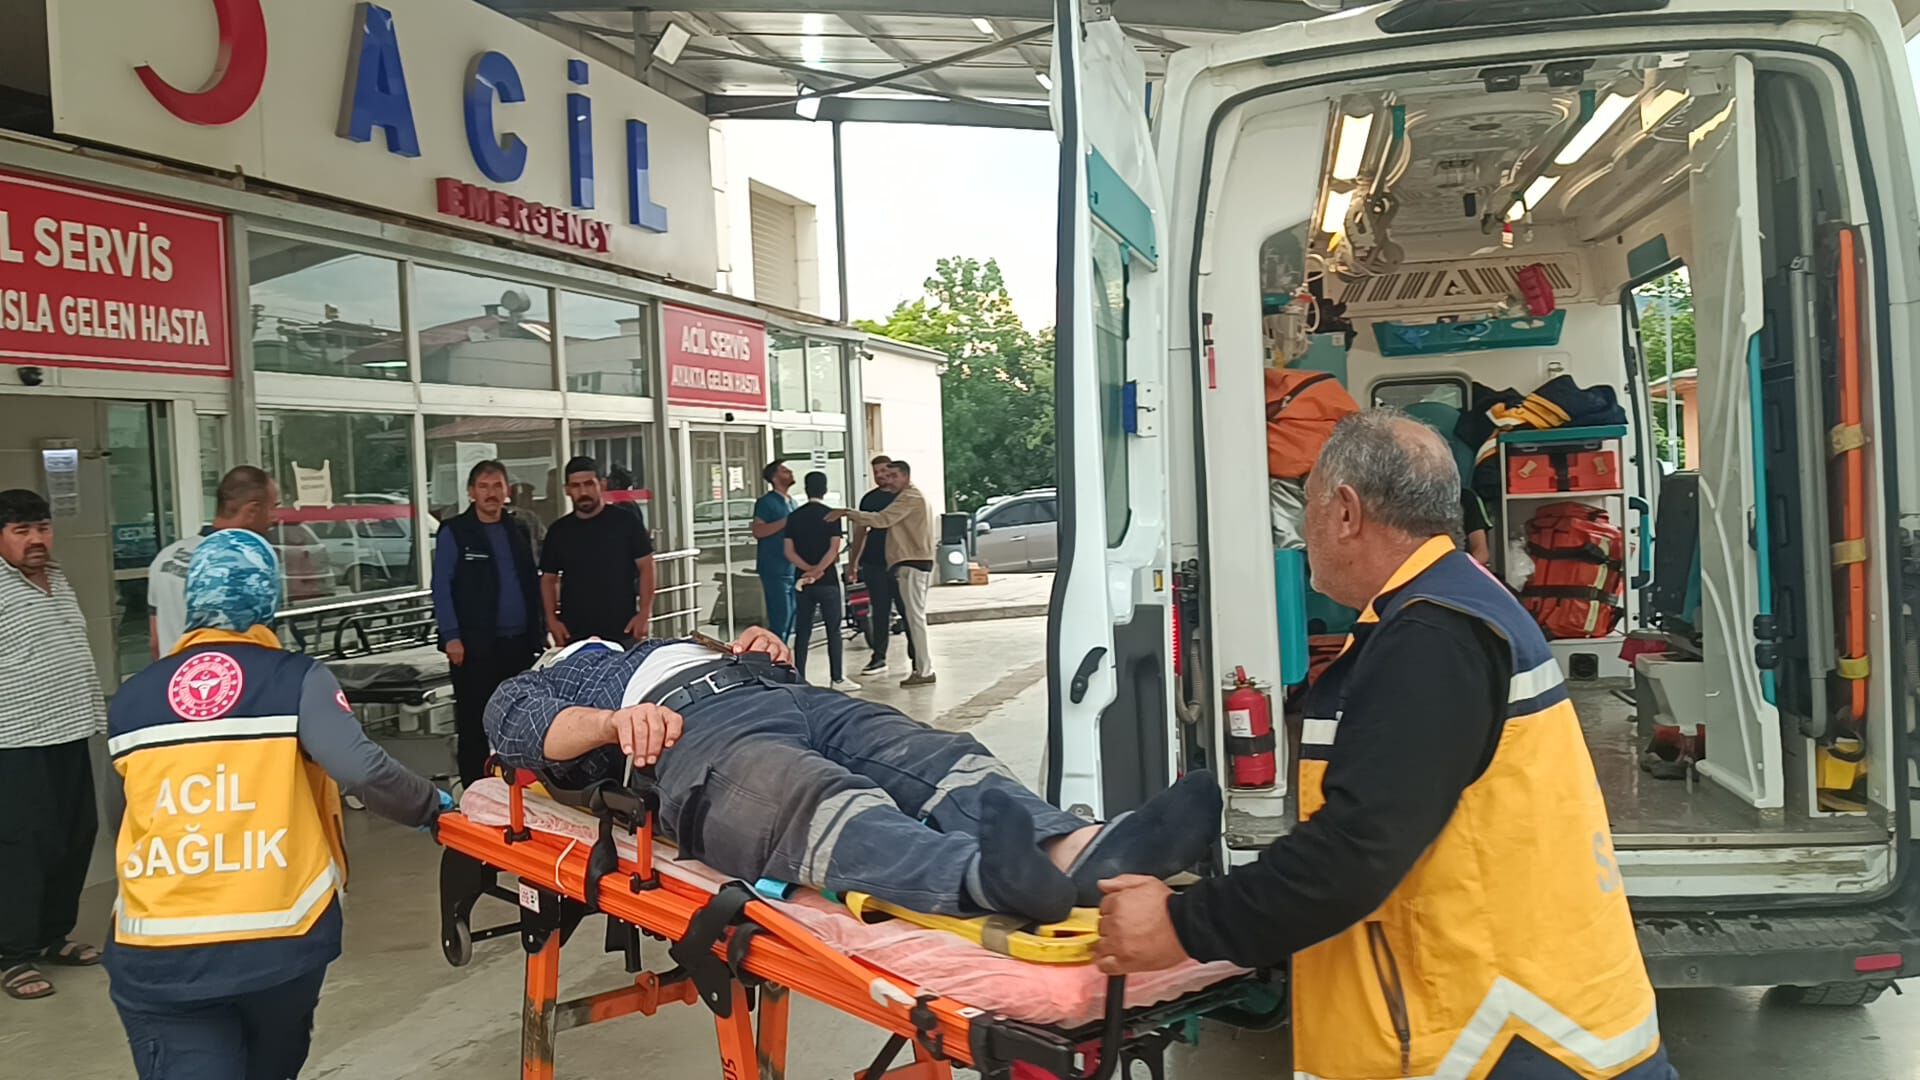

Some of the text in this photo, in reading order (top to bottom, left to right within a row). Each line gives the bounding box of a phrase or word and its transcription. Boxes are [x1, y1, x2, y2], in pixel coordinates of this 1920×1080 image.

[336, 2, 668, 233] ACİL
[436, 177, 613, 253] EMERGENCY
[34, 216, 173, 282] SERVİS
[60, 295, 136, 340] GELEN
[140, 304, 210, 346] HASTA
[150, 763, 256, 819] ACİL
[123, 823, 288, 879] SAĞLIK
